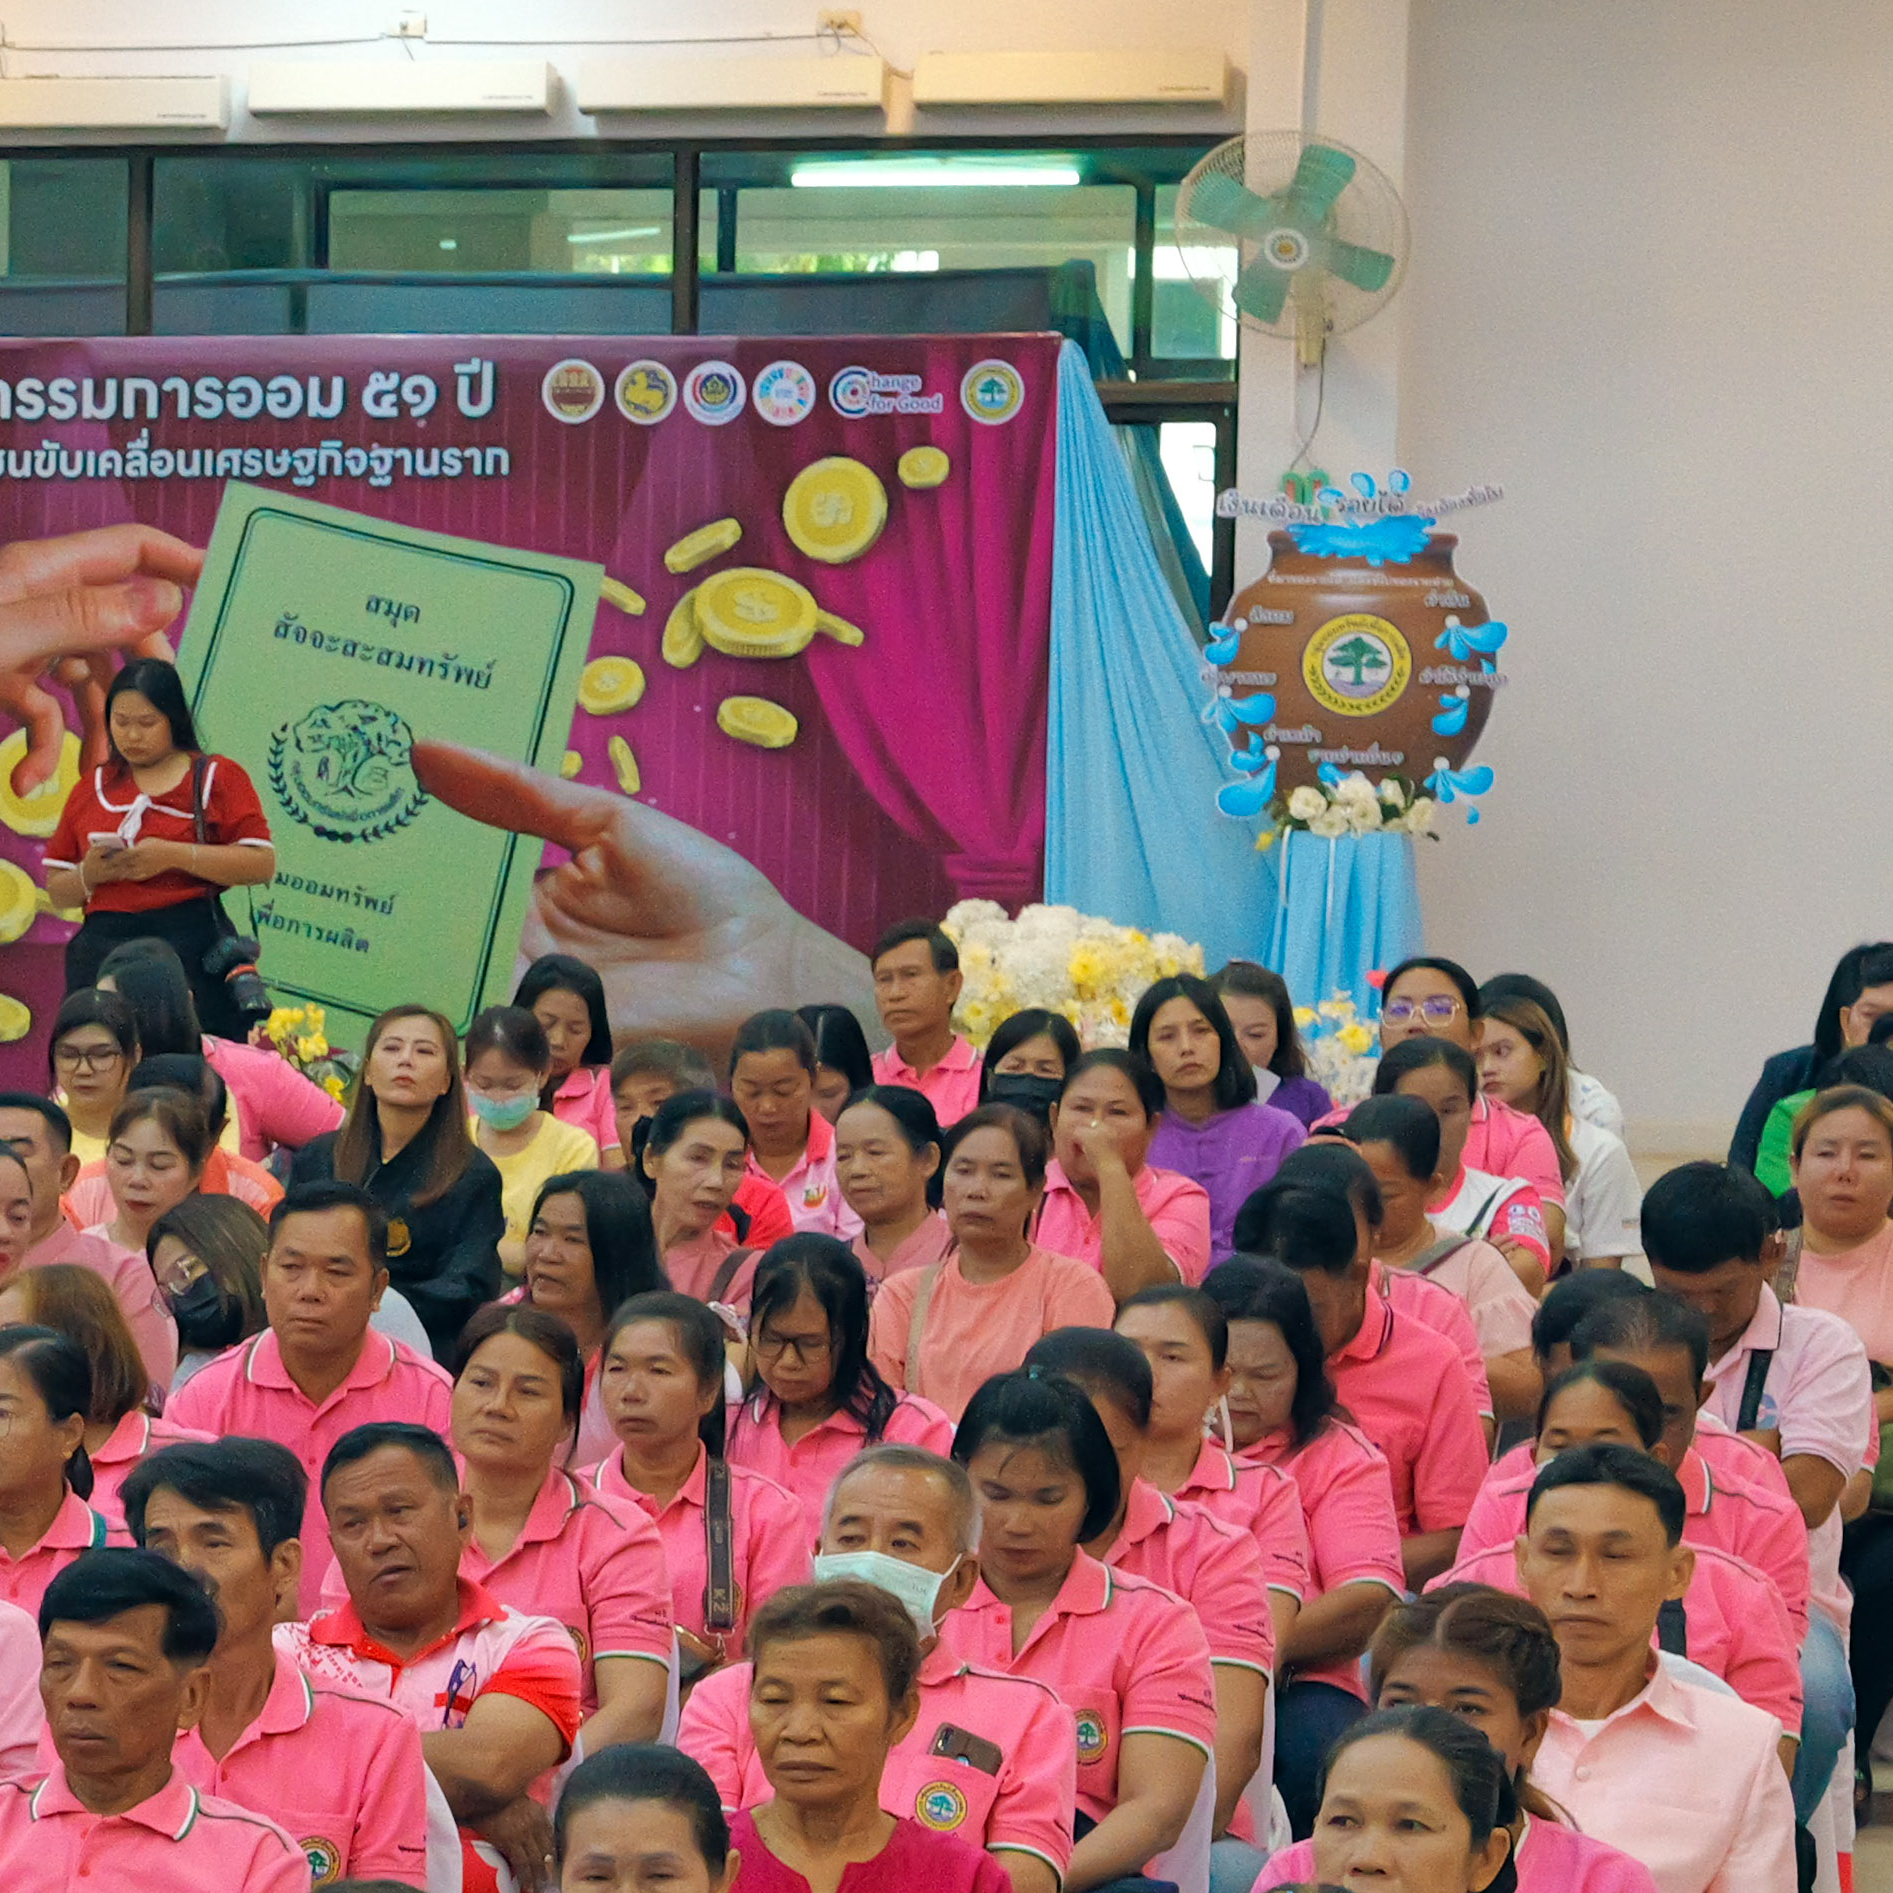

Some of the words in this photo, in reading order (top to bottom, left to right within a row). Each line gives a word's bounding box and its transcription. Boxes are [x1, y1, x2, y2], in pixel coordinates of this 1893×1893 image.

[361, 371, 438, 422] ๕๑
[454, 358, 495, 417] ปี
[870, 395, 895, 412] for
[897, 395, 941, 412] Good
[365, 594, 422, 629] สมุด
[273, 611, 496, 690] สัจจะสะสมทรัพย์
[274, 871, 397, 916] มออมทรัพย์
[256, 898, 371, 954] พื่อการผลิต
